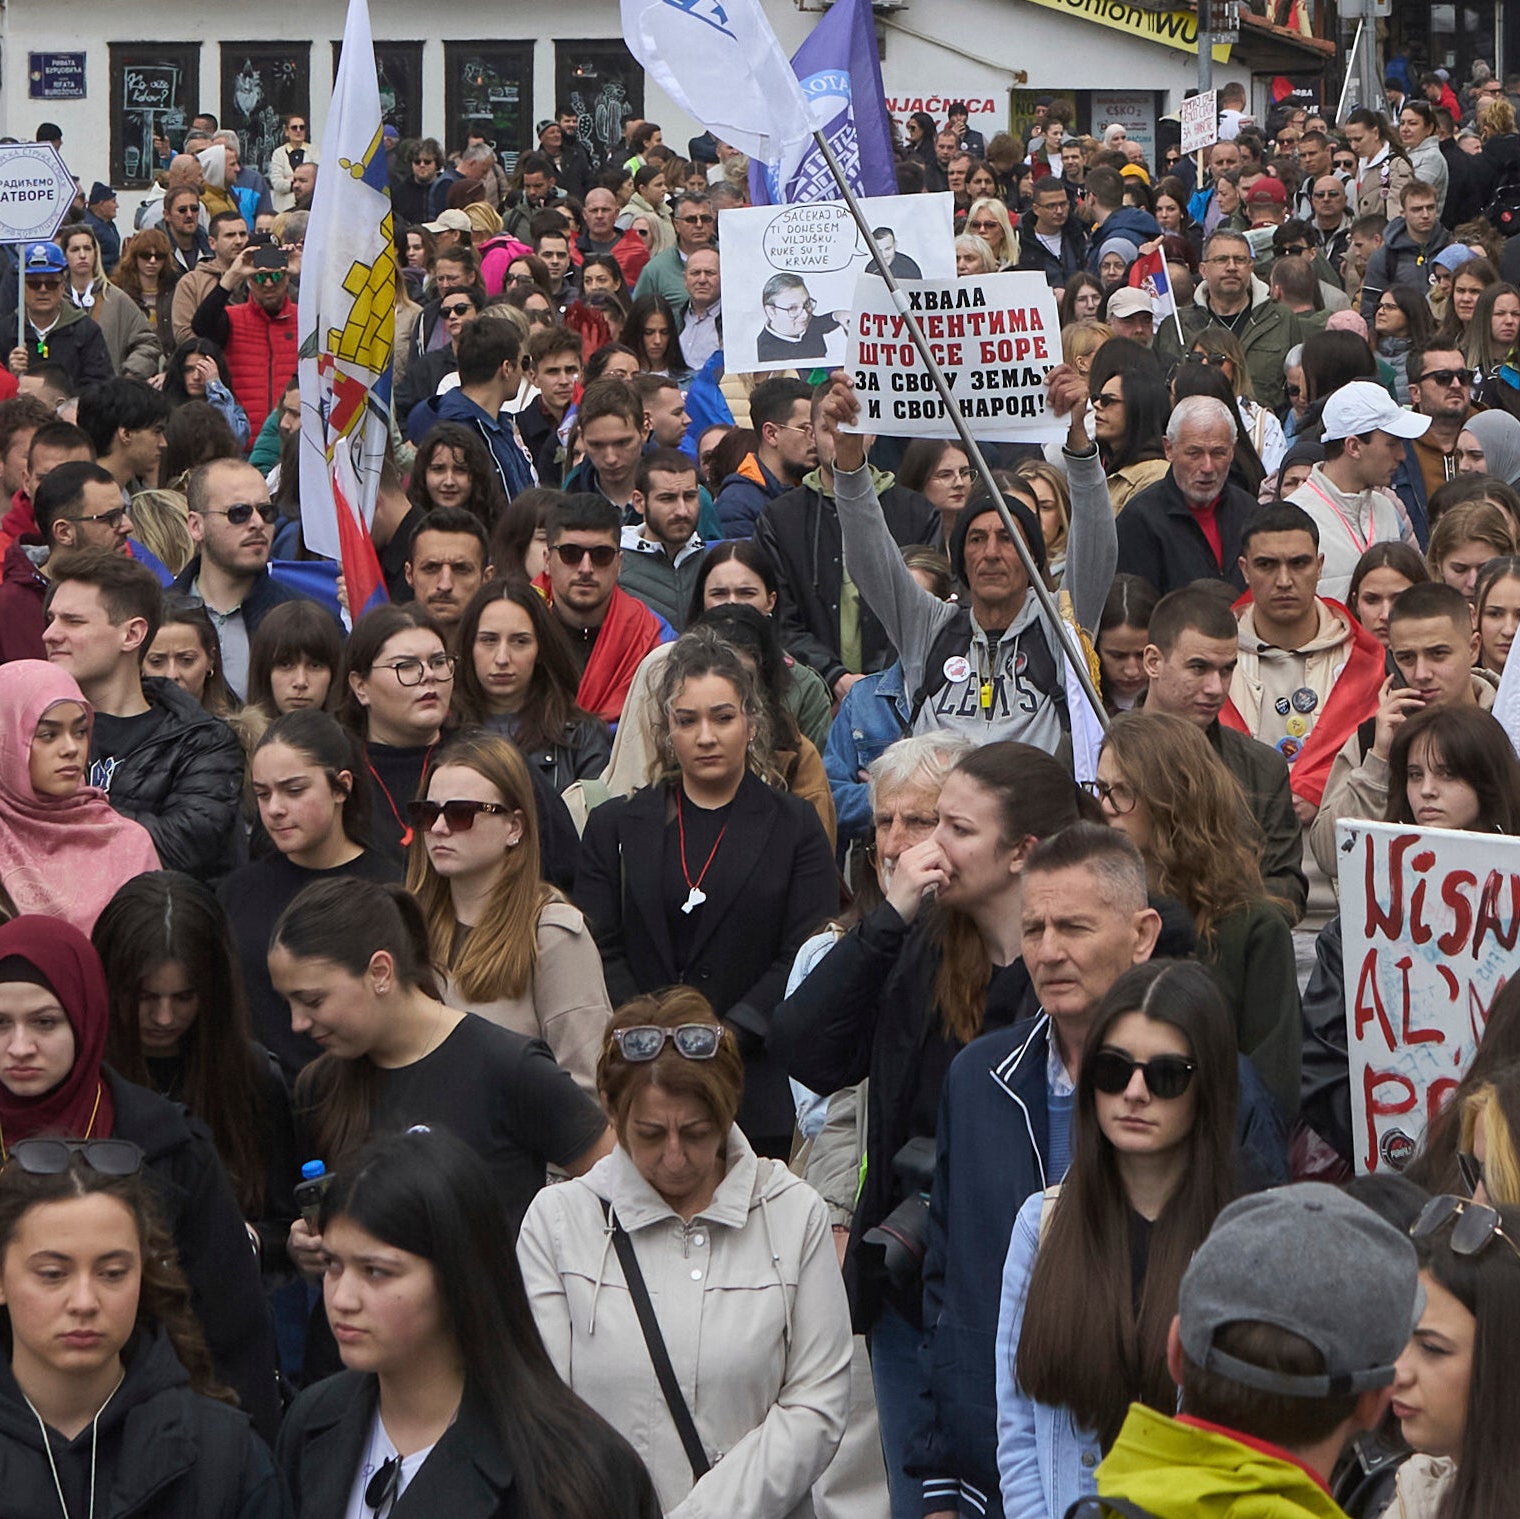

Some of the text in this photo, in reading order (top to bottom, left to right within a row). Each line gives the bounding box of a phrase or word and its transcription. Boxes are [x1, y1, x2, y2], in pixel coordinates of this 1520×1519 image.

[782, 209, 848, 223] SAČEKAJ DA
[770, 223, 839, 234] TI DONESEM
[770, 245, 828, 256] RUKE SU TI
[785, 255, 829, 266] KRVAVE
[908, 287, 986, 311] ХВАЛА
[859, 341, 915, 367] ШТО
[980, 336, 1048, 364] БОРЕ
[855, 370, 880, 392] ЗА
[891, 372, 958, 392] СВОУ
[868, 399, 881, 419] И
[959, 394, 1045, 418] НАРОД!
